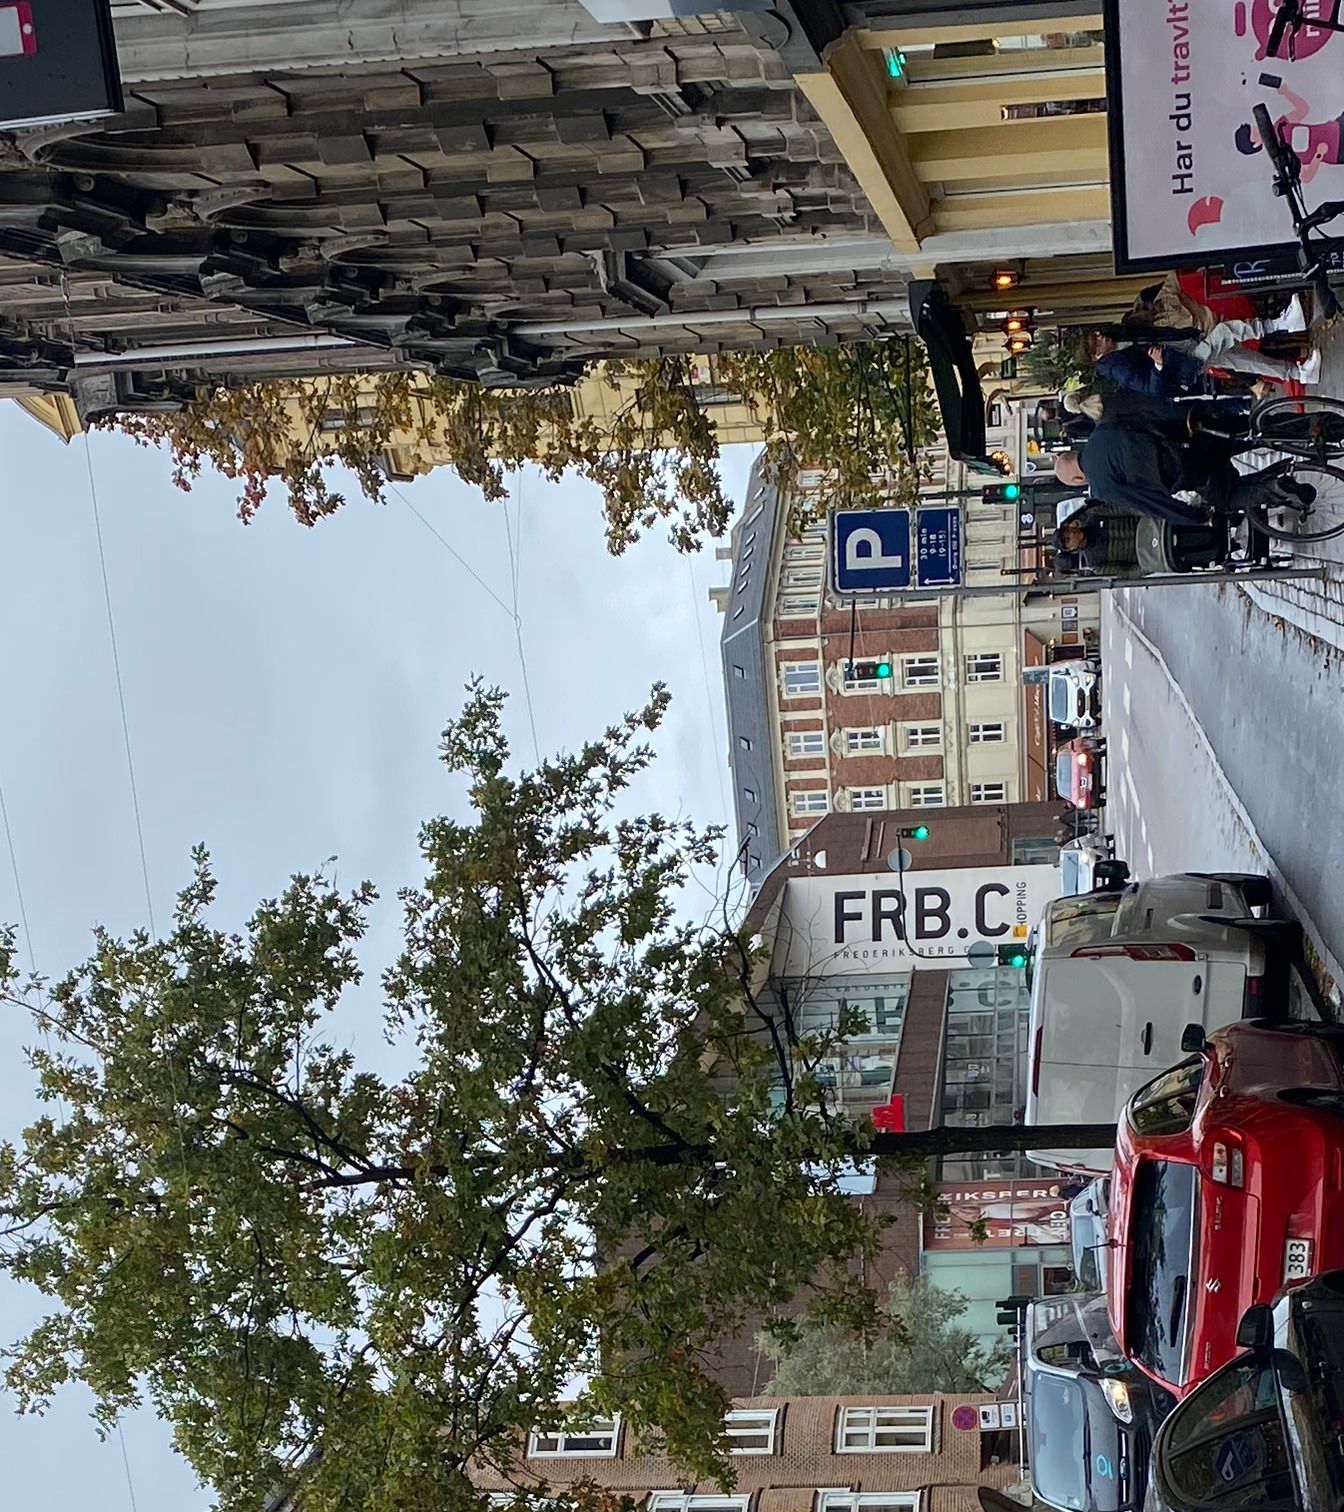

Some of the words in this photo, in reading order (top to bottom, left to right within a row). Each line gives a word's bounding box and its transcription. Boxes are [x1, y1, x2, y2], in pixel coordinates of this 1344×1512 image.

[1166, 0, 1192, 86] travlt
[1169, 92, 1192, 132] du
[1171, 140, 1193, 195] Har
[845, 527, 902, 571] P
[834, 882, 1011, 944] FRB.C
[1288, 1241, 1306, 1274] 383
